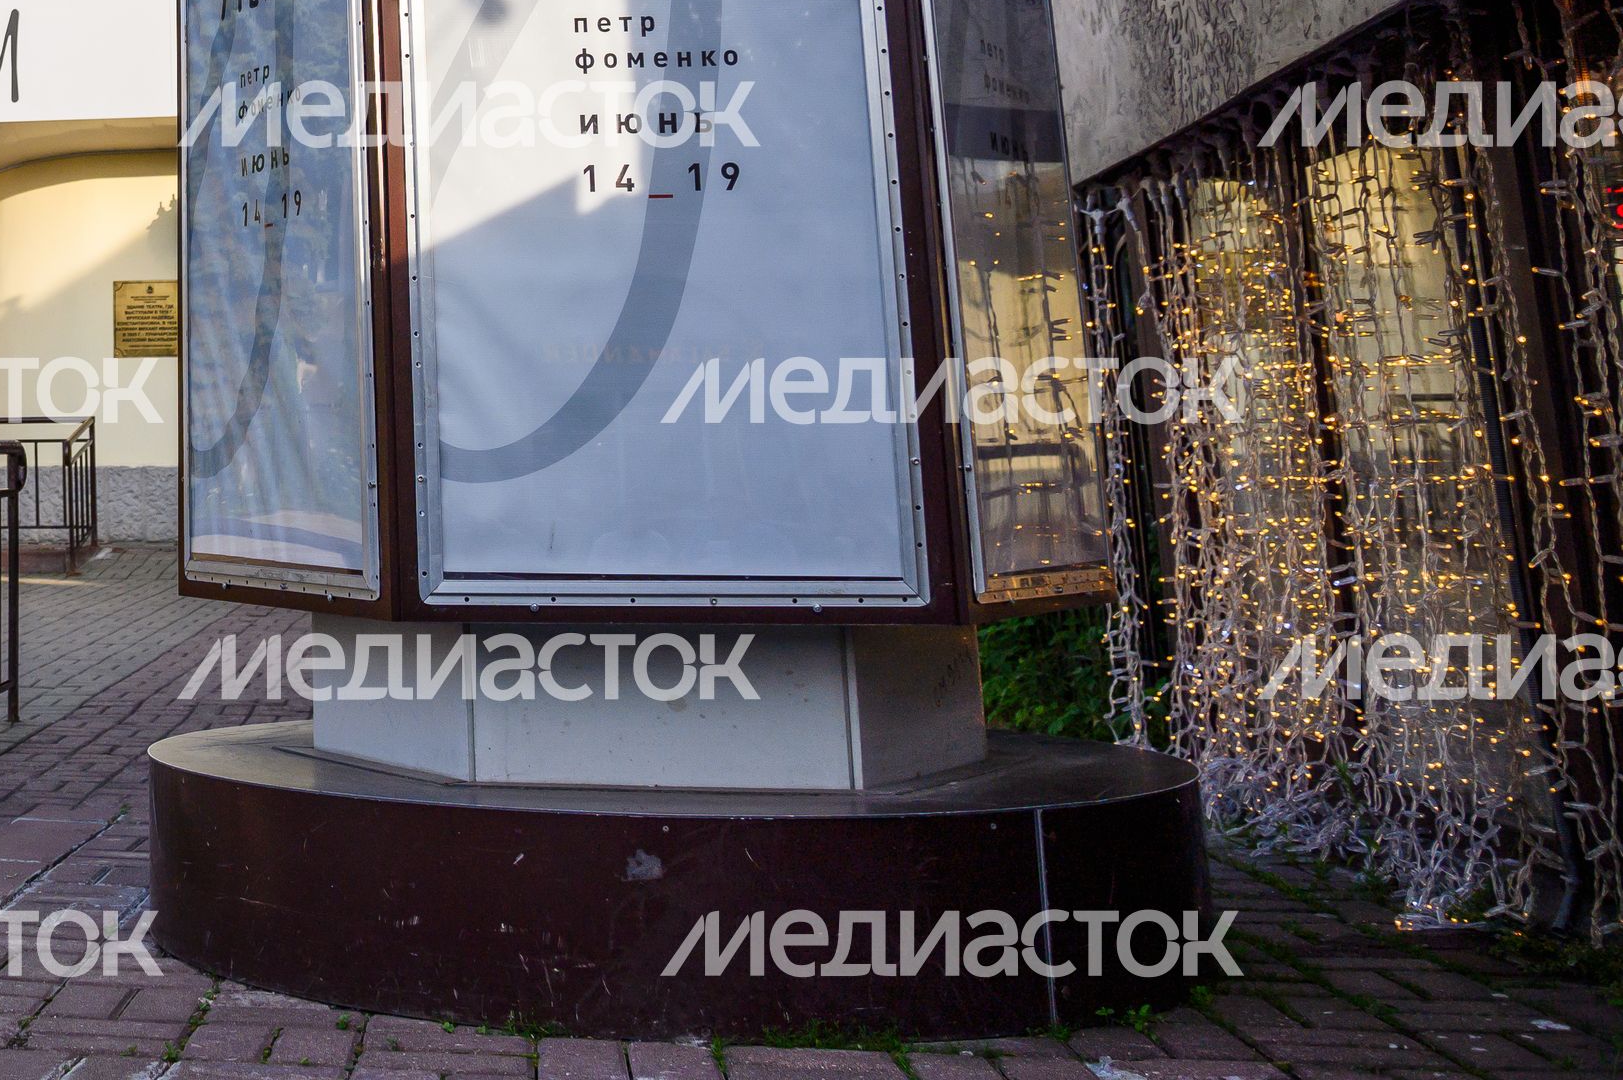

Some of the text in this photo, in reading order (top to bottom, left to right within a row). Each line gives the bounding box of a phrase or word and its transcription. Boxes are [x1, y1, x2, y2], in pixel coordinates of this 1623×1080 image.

[573, 14, 656, 37] петр
[574, 47, 739, 74] фоменко
[239, 64, 271, 89] петр
[237, 86, 302, 121] фоменко
[579, 111, 714, 135] июнь
[240, 150, 290, 179] июнь
